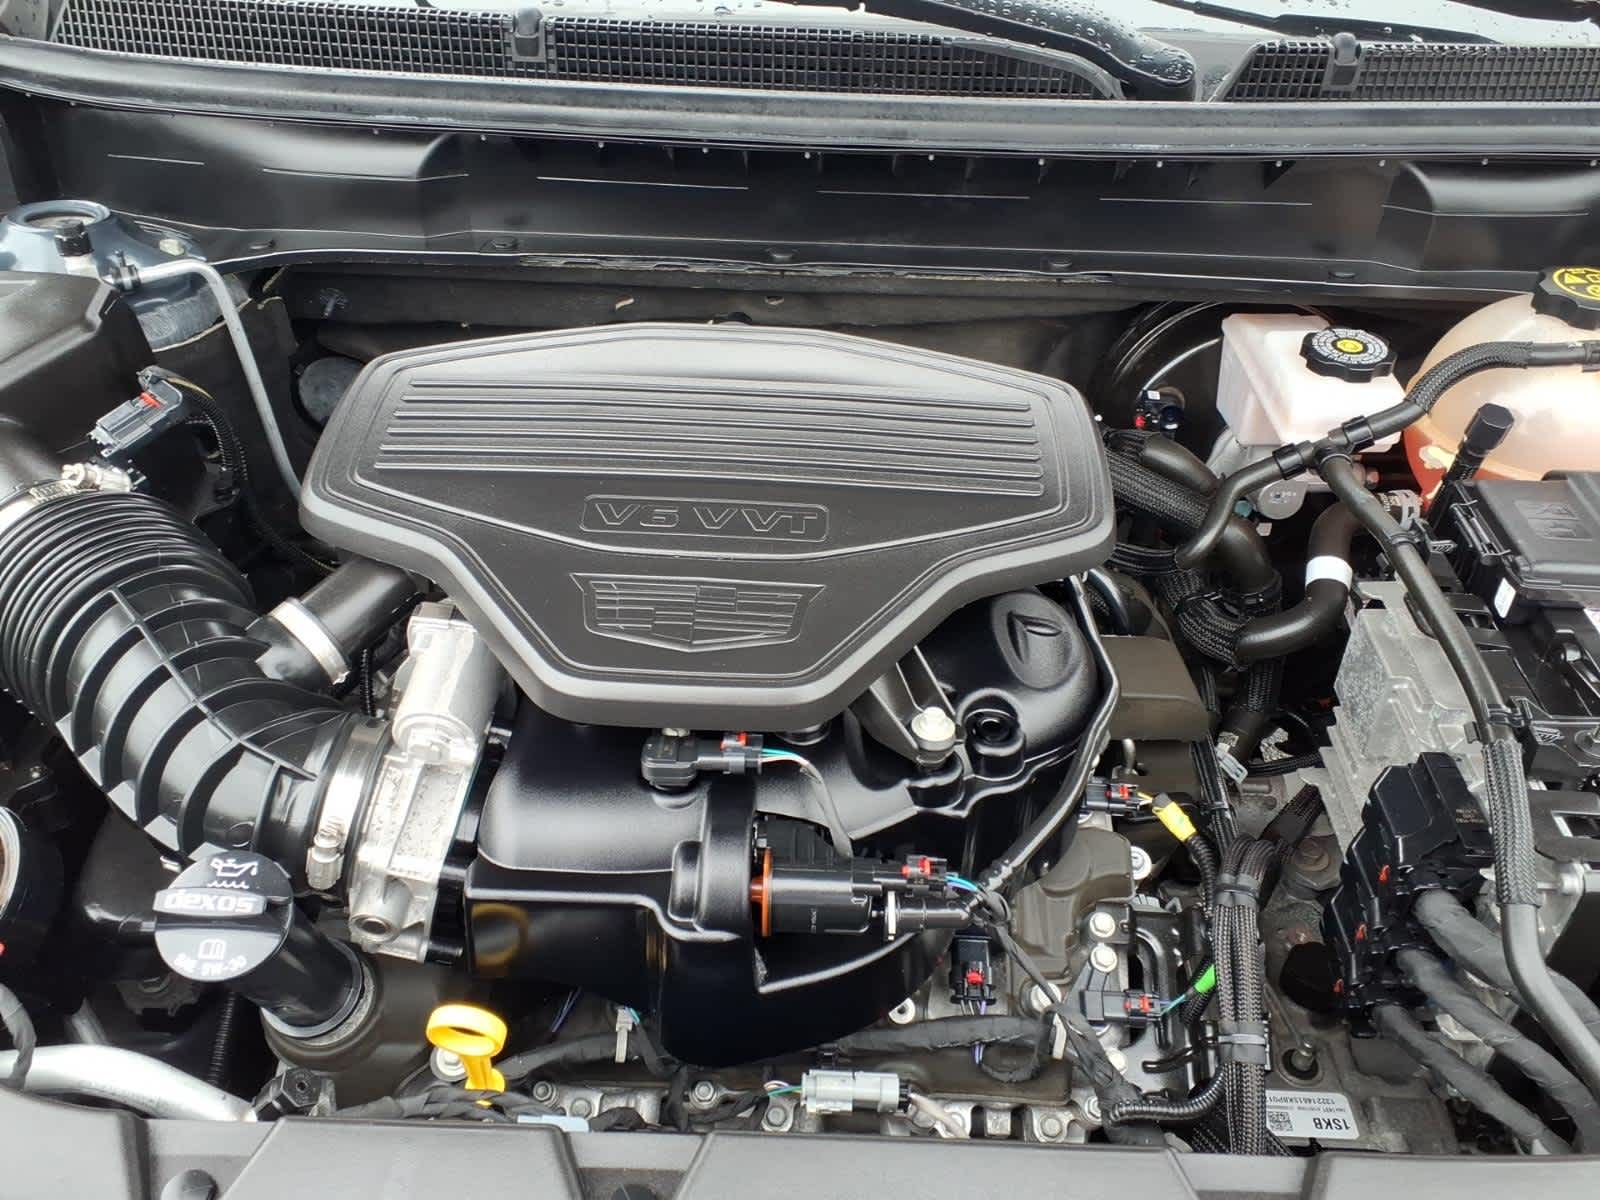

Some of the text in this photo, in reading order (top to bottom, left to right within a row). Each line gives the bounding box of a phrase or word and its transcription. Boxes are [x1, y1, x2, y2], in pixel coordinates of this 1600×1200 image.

[595, 503, 818, 534] V6 VVT
[164, 889, 256, 913] dexos
[1313, 1117, 1351, 1131] 1SKB
